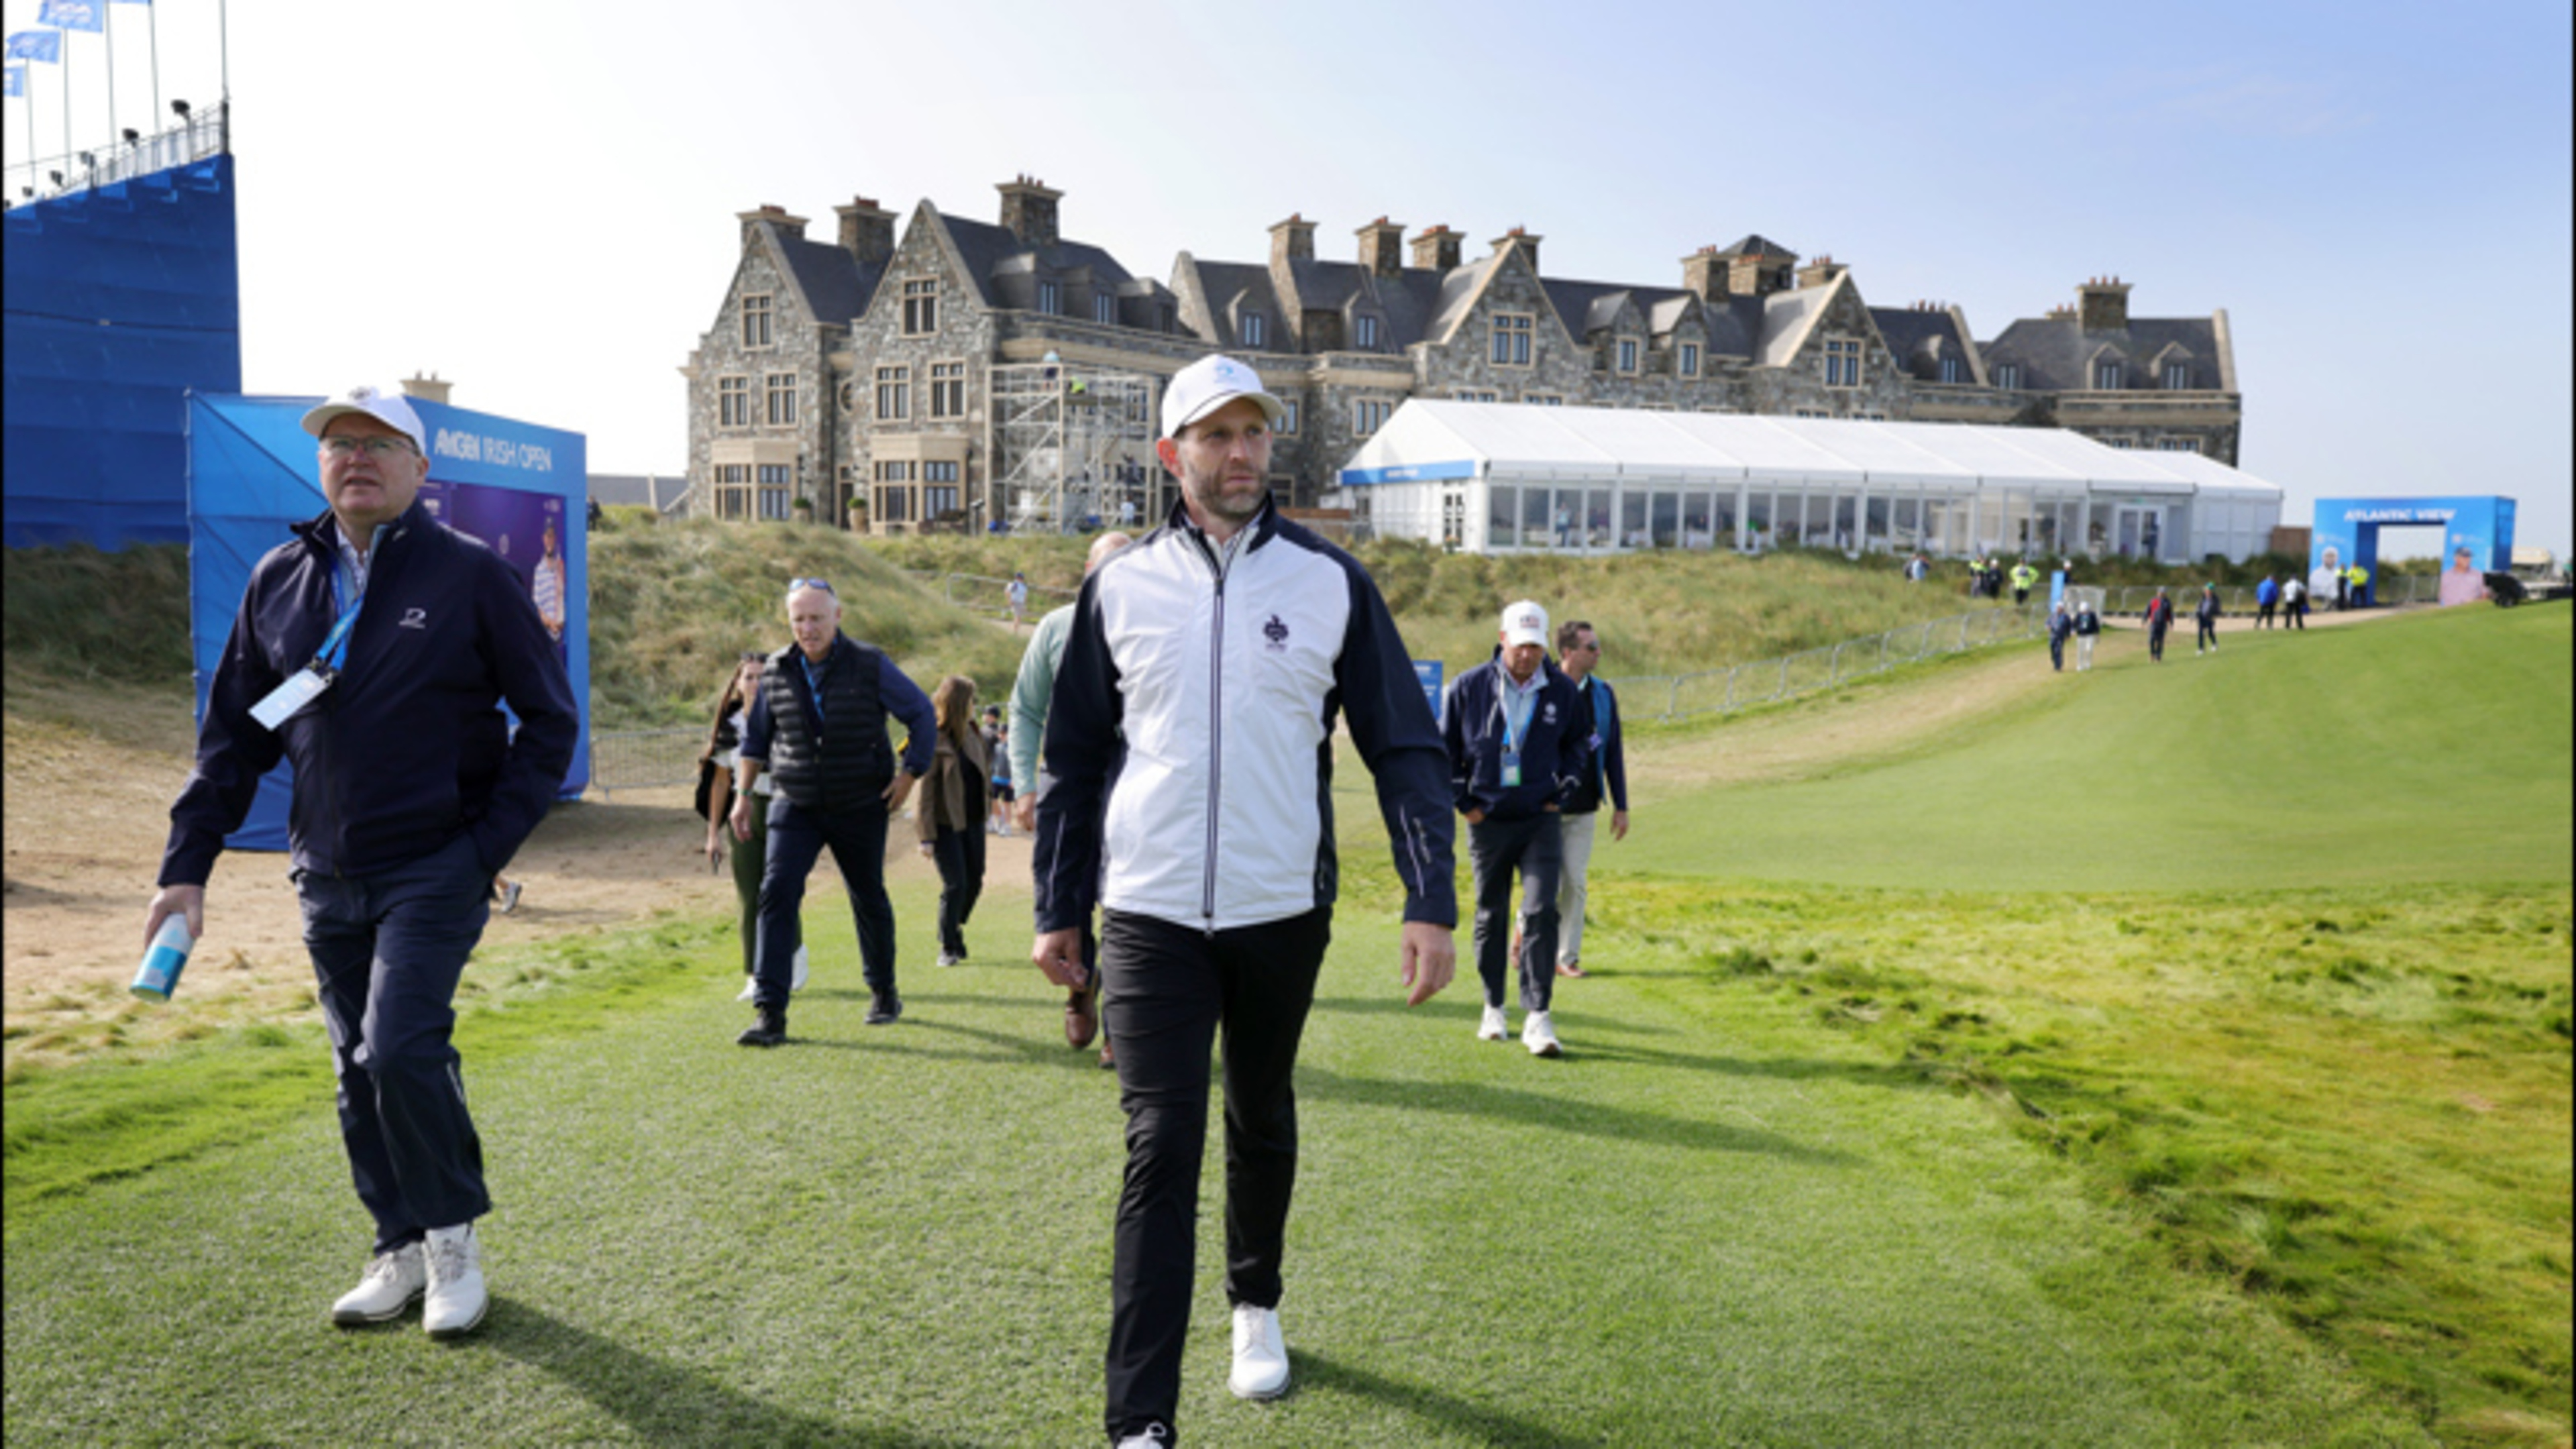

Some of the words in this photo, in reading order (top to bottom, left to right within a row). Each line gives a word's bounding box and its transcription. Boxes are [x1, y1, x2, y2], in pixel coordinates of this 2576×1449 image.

[483, 437, 516, 466] IRISH
[519, 443, 551, 471] OPEN
[2344, 508, 2412, 521] ATLANTIC
[2416, 508, 2456, 520] VIEW
